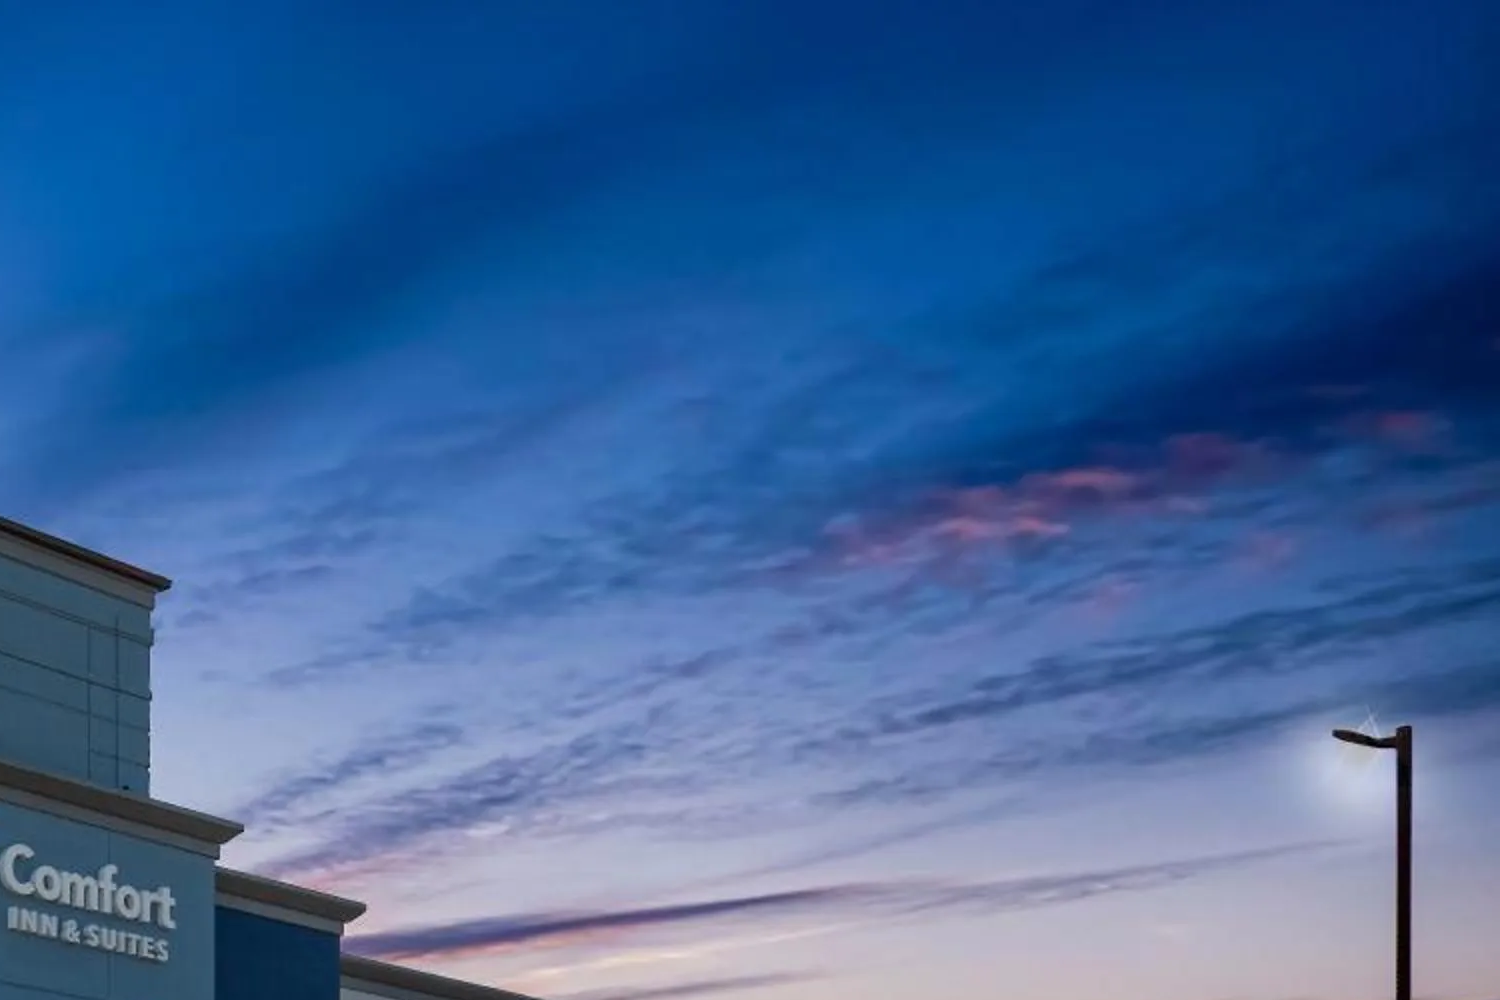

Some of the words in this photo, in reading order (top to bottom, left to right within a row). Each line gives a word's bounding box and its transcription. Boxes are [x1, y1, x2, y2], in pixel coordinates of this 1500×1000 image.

[7, 906, 58, 938] INN
[61, 918, 81, 944] &
[83, 923, 169, 962] SUITES
